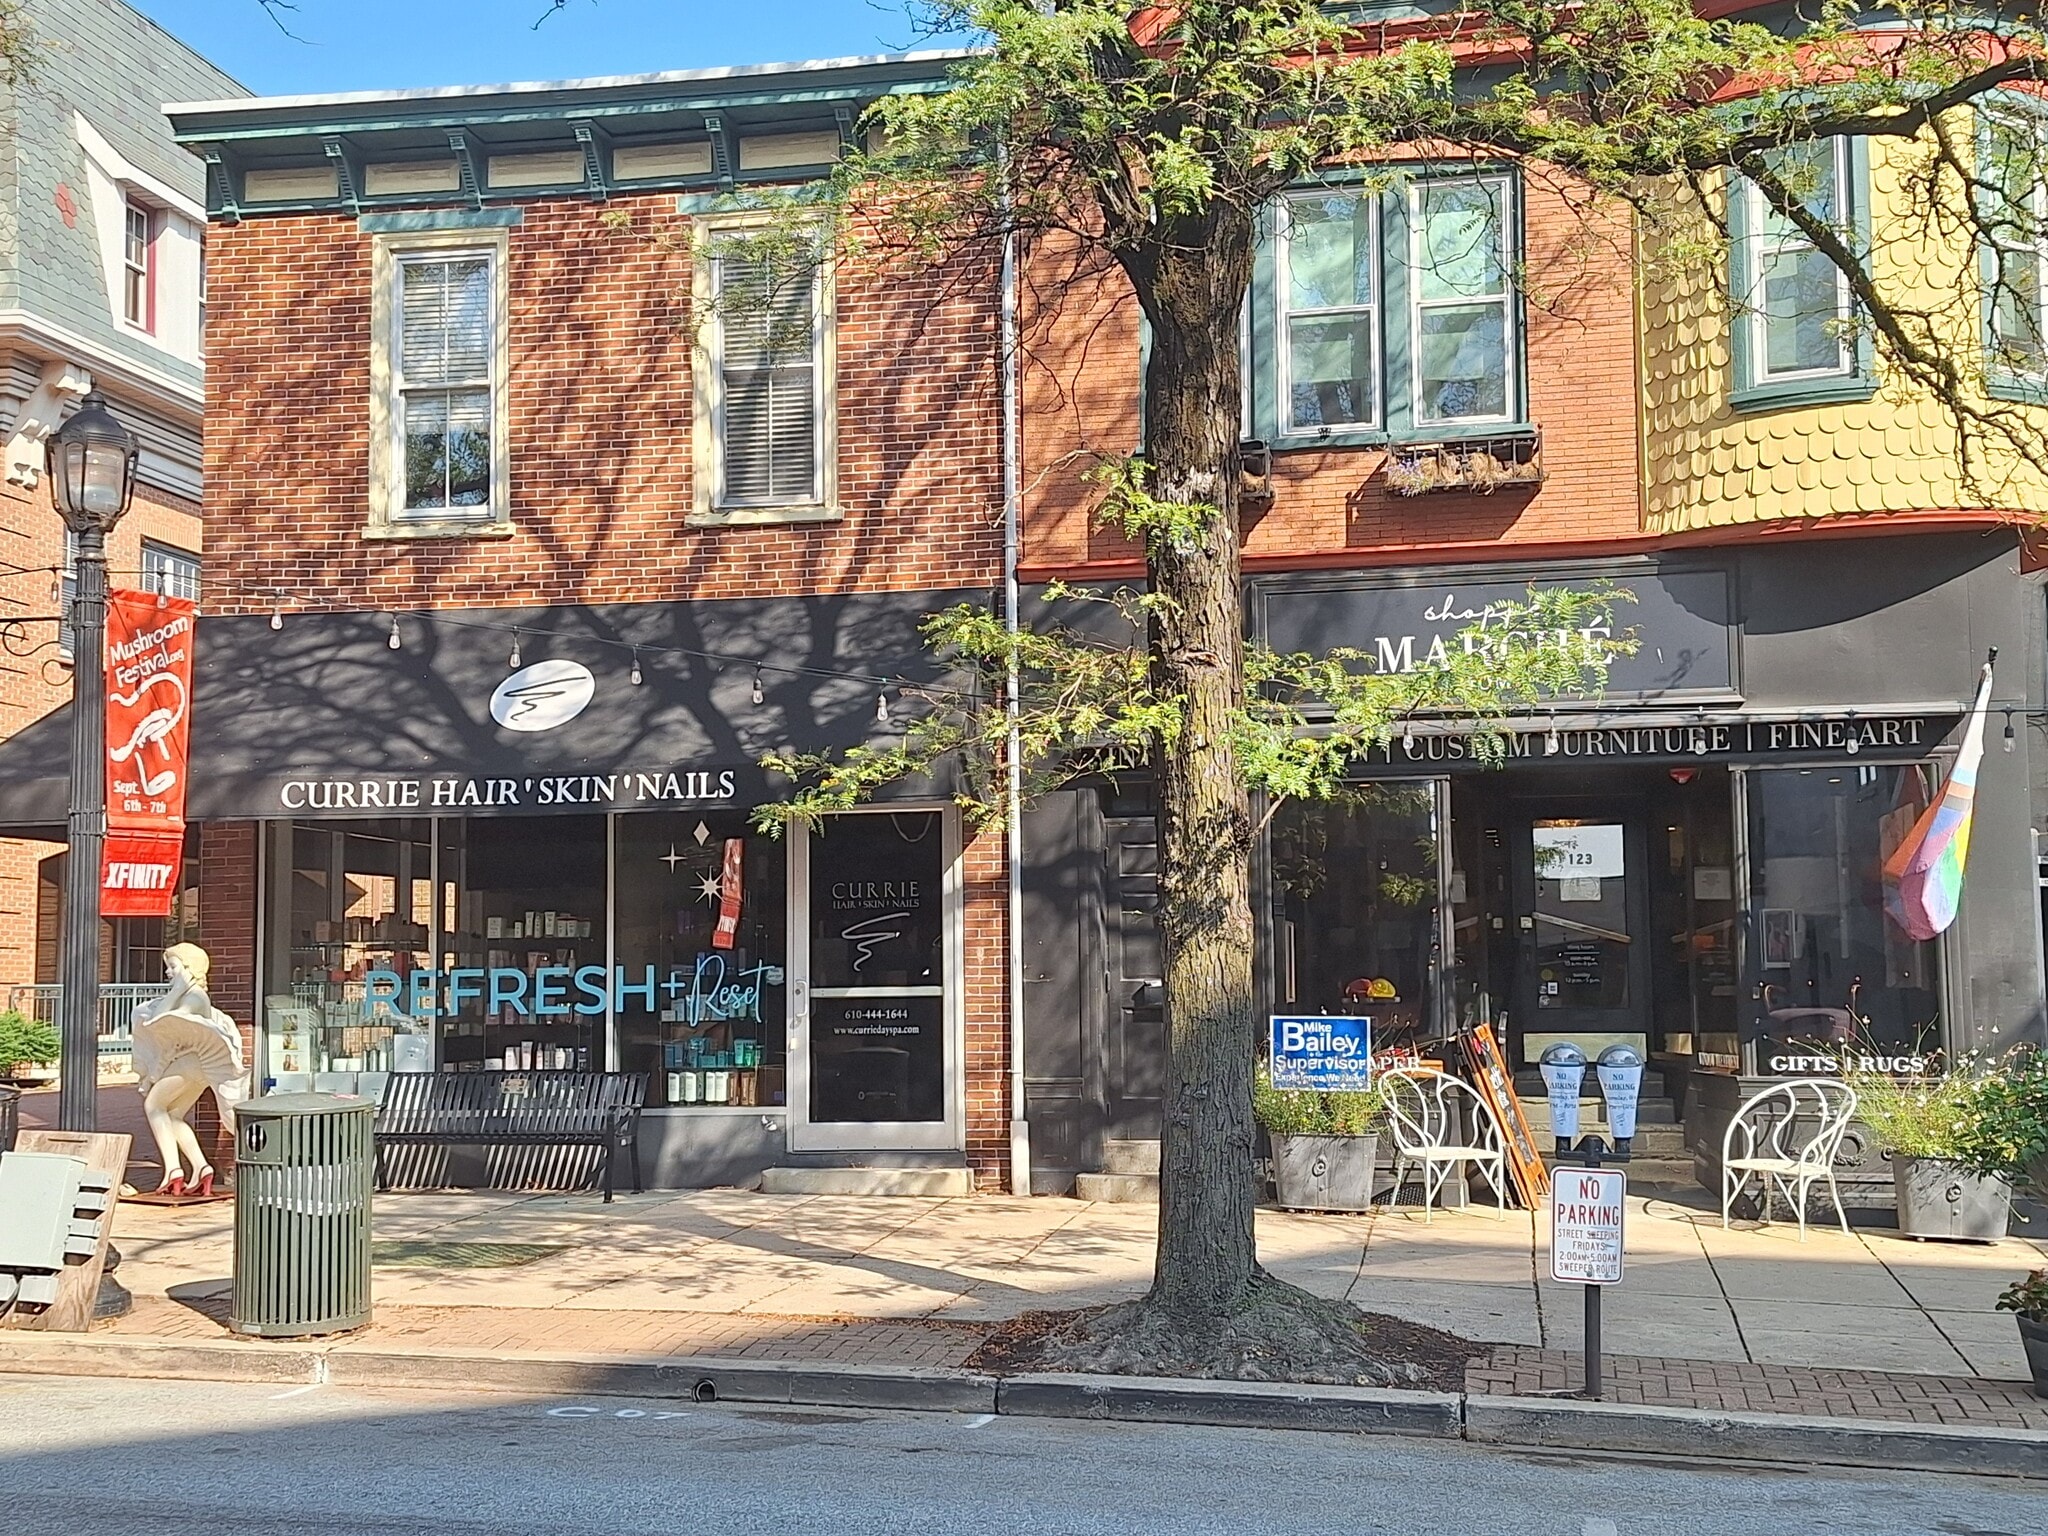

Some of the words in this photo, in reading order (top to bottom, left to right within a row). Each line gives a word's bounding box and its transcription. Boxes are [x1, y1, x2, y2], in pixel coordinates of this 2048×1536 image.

[110, 617, 189, 666] Mushroom
[1768, 722, 1846, 749] FINE
[1857, 719, 1925, 746] ART
[113, 780, 141, 798] Sept.
[281, 780, 420, 809] CURRIE
[123, 800, 142, 812] 6th
[150, 801, 167, 814] 7th
[1568, 853, 1593, 865] 123
[104, 862, 173, 889] XFINITY
[832, 881, 920, 899] CURRIE
[364, 964, 655, 1017] REFRESH
[844, 1008, 909, 1019] 610-444-1644
[1303, 1021, 1333, 1033] Mike
[1275, 1054, 1366, 1073] Supervisor
[1770, 1055, 1838, 1072] GIFTS
[1858, 1056, 1925, 1073] RUGS
[1556, 1071, 1567, 1080] NO
[1612, 1073, 1624, 1081] NO
[1549, 1082, 1577, 1090] ARKING
[1579, 1178, 1600, 1200] NO
[1558, 1203, 1619, 1226] PARKING
[1557, 1228, 1583, 1239] STREET
[1595, 1264, 1618, 1275] ROUTE
